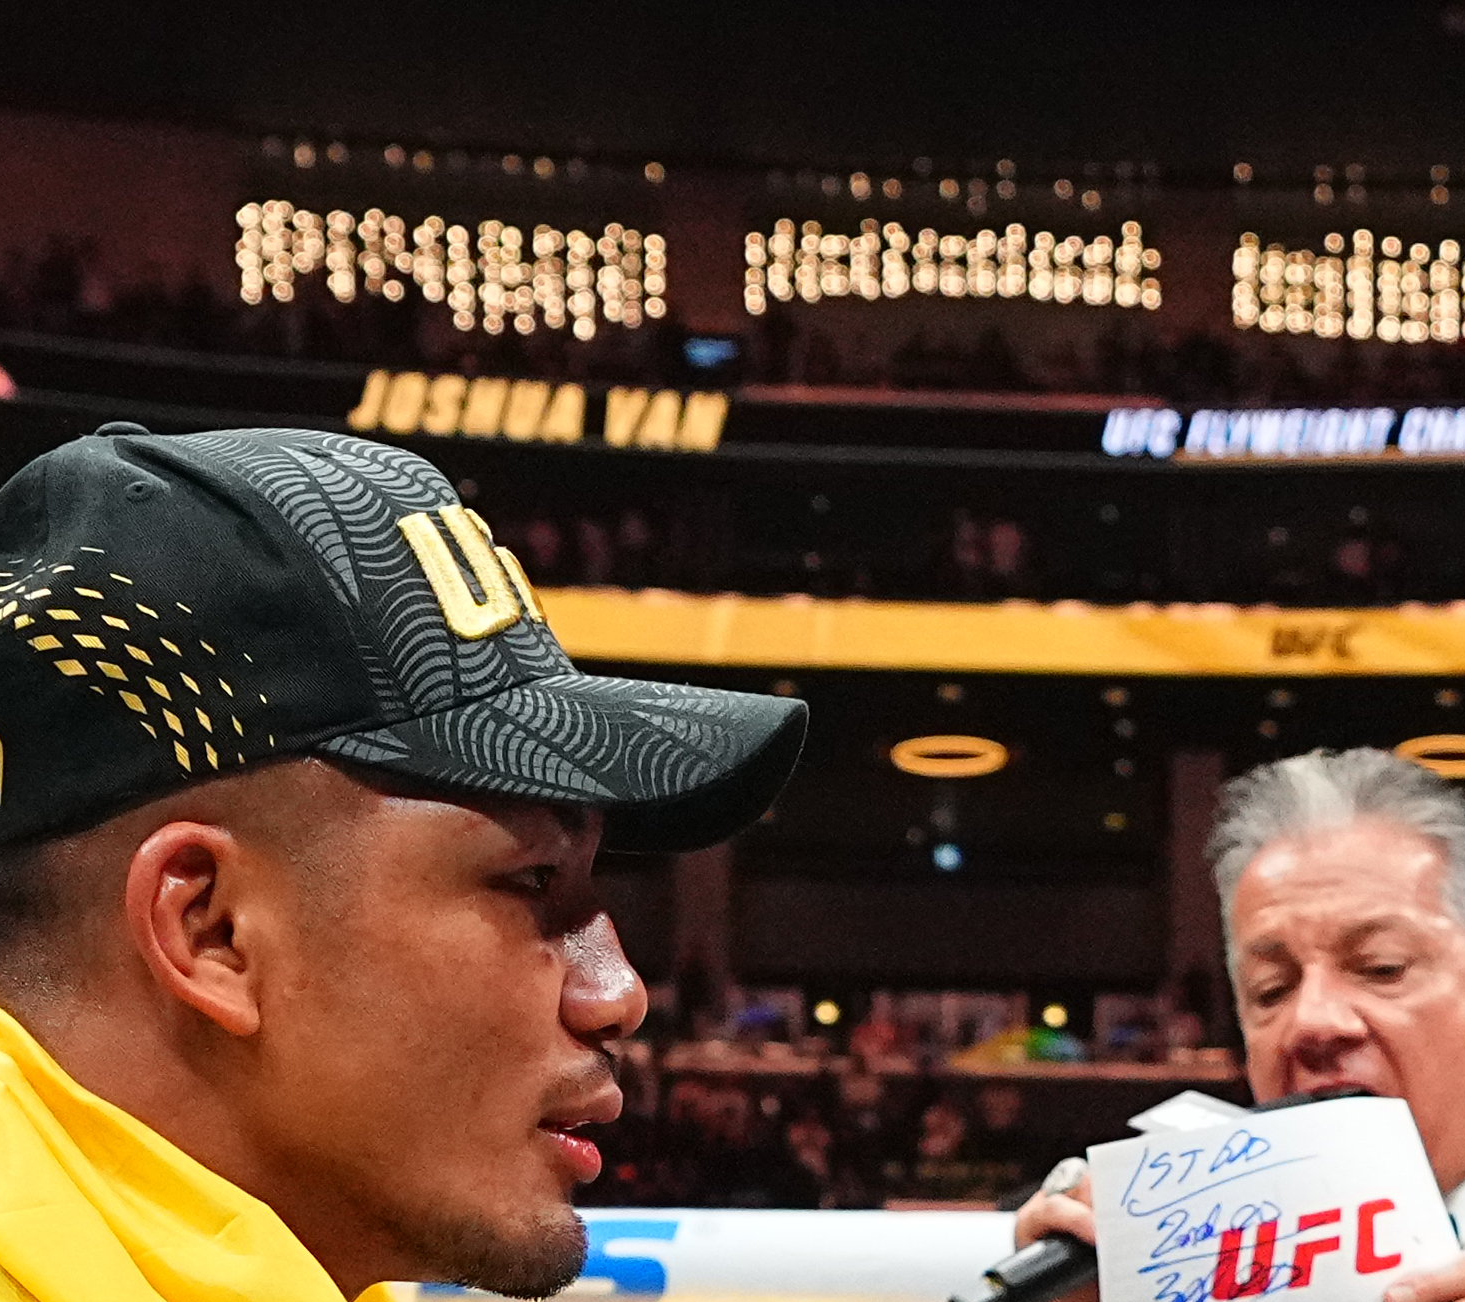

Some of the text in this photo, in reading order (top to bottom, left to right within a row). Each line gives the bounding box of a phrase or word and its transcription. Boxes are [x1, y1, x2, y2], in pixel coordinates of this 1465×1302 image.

[348, 369, 729, 452] JOSHUA VAN
[1210, 1198, 1401, 1301] UFC
